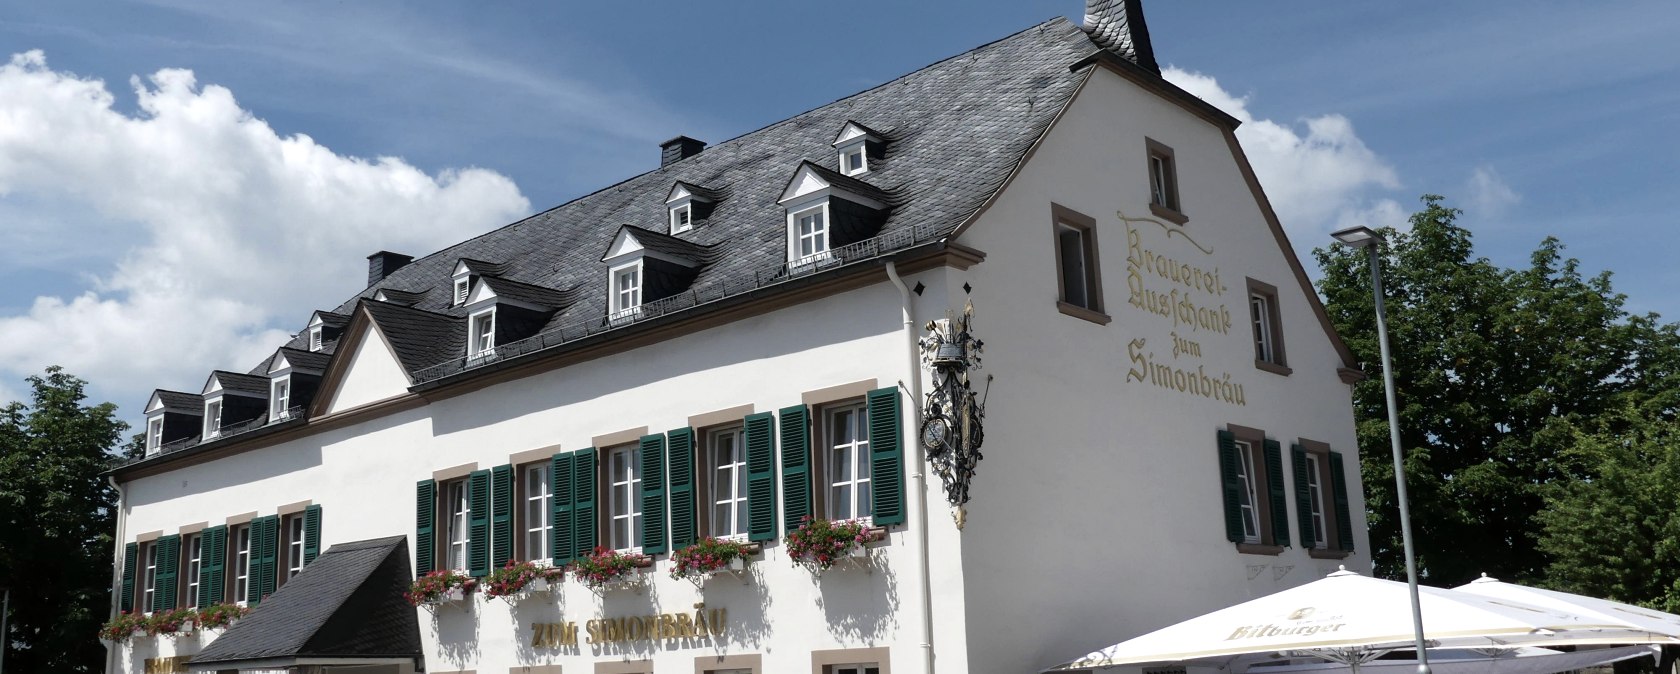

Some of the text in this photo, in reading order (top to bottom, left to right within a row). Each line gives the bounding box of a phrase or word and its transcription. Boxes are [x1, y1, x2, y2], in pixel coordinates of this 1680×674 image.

[1126, 337, 1246, 406] Simonbräu
[531, 602, 727, 649] ZUM SIMONBRÄU
[1223, 622, 1346, 641] Bitburger
